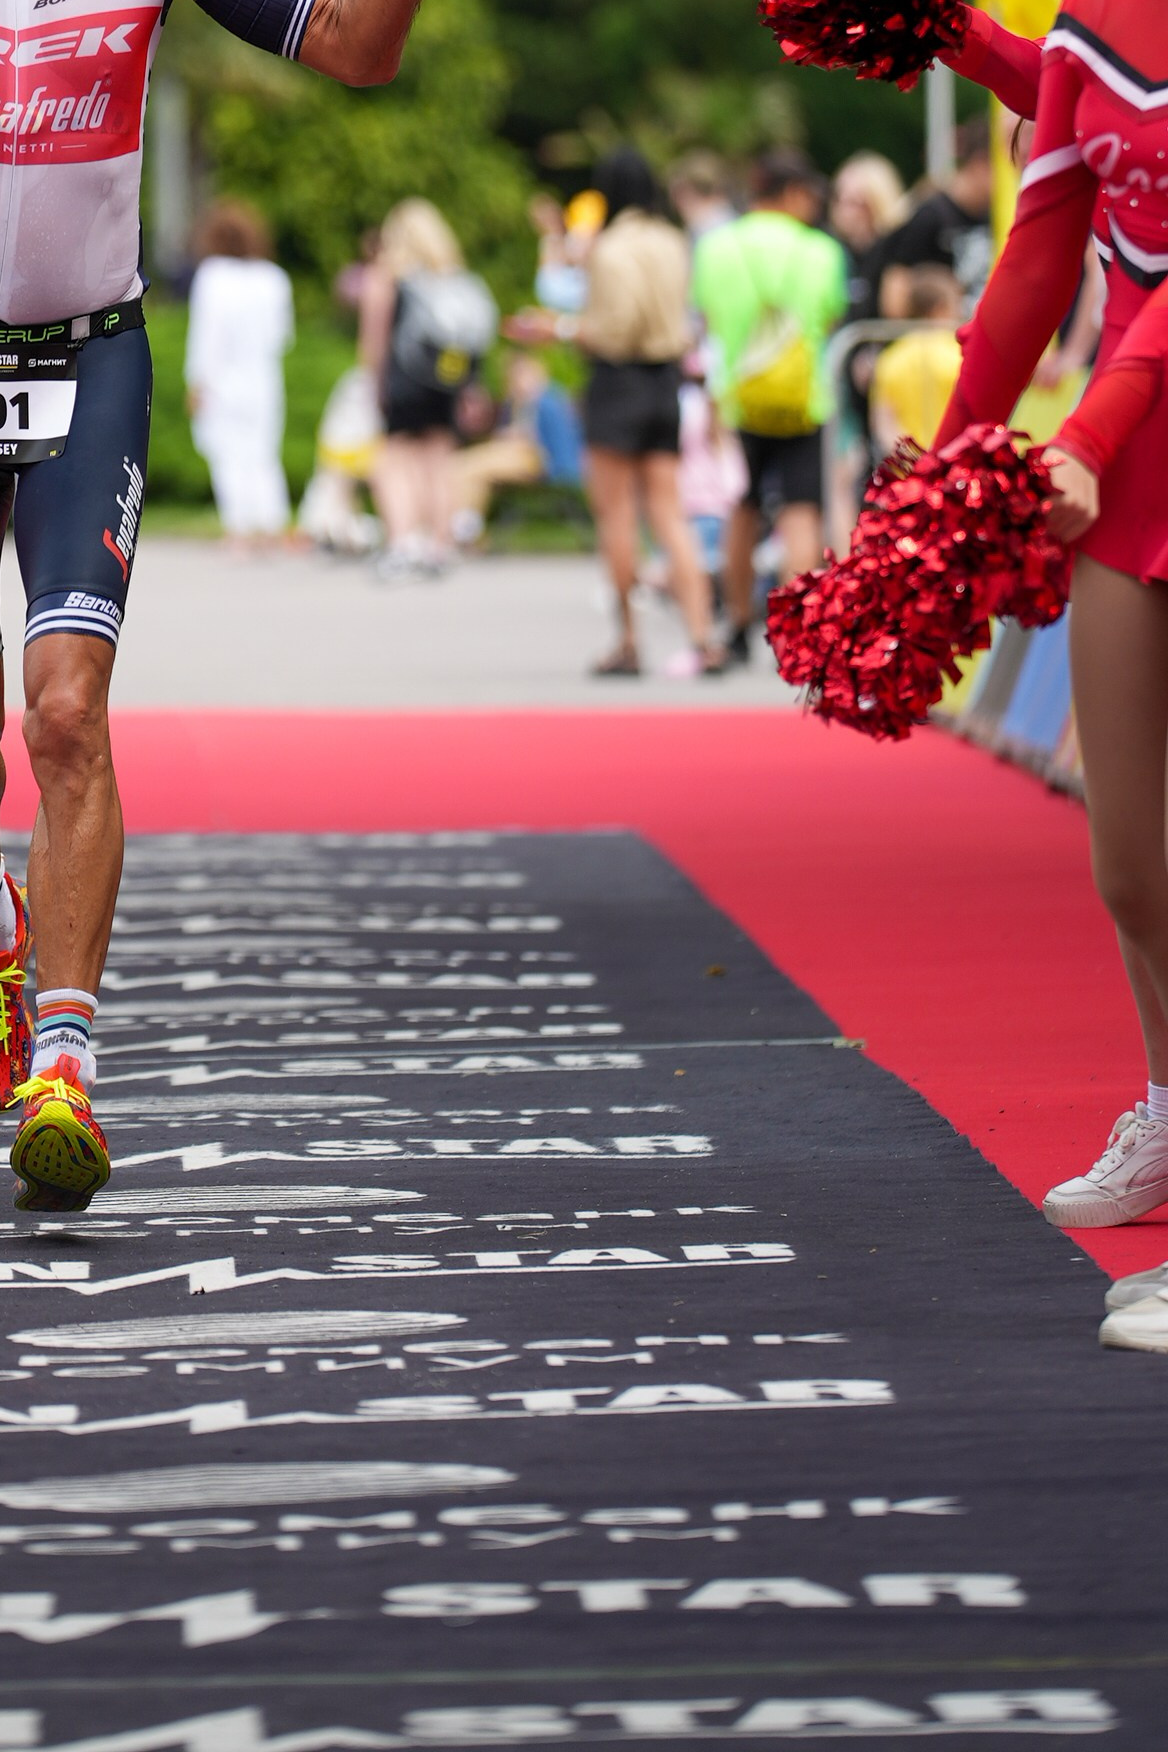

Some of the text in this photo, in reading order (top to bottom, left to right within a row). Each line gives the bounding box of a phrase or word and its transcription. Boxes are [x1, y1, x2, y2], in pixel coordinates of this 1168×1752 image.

[37, 358, 67, 367] МАГНИТ
[301, 1134, 713, 1156] STAR
[329, 1243, 797, 1272] STAR
[354, 1379, 894, 1416] STAR
[378, 1572, 1028, 1618] STAR
[400, 1688, 1115, 1739] STAR
